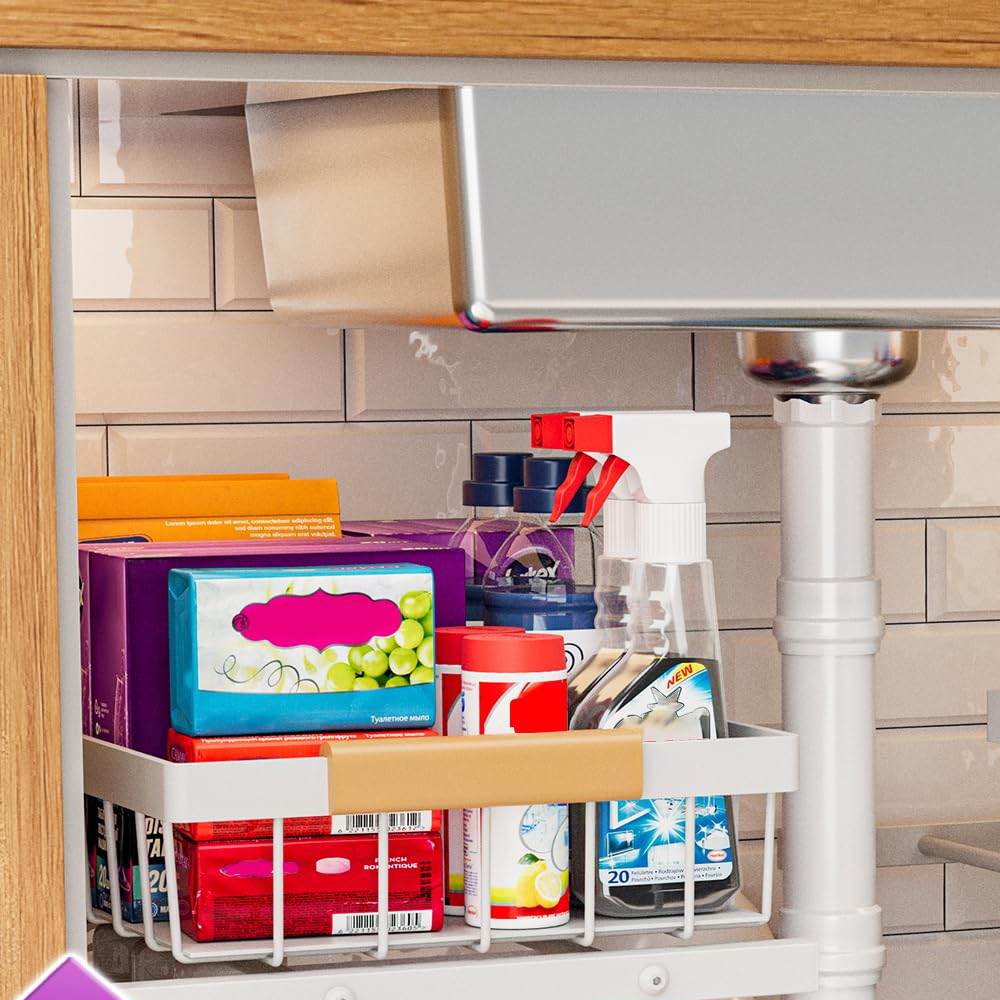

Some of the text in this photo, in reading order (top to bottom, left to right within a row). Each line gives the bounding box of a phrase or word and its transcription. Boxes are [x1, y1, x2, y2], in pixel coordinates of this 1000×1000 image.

[666, 664, 694, 689] NEW
[370, 714, 430, 724] Туалетное мыло
[146, 838, 166, 858] TA
[607, 870, 630, 884] 20
